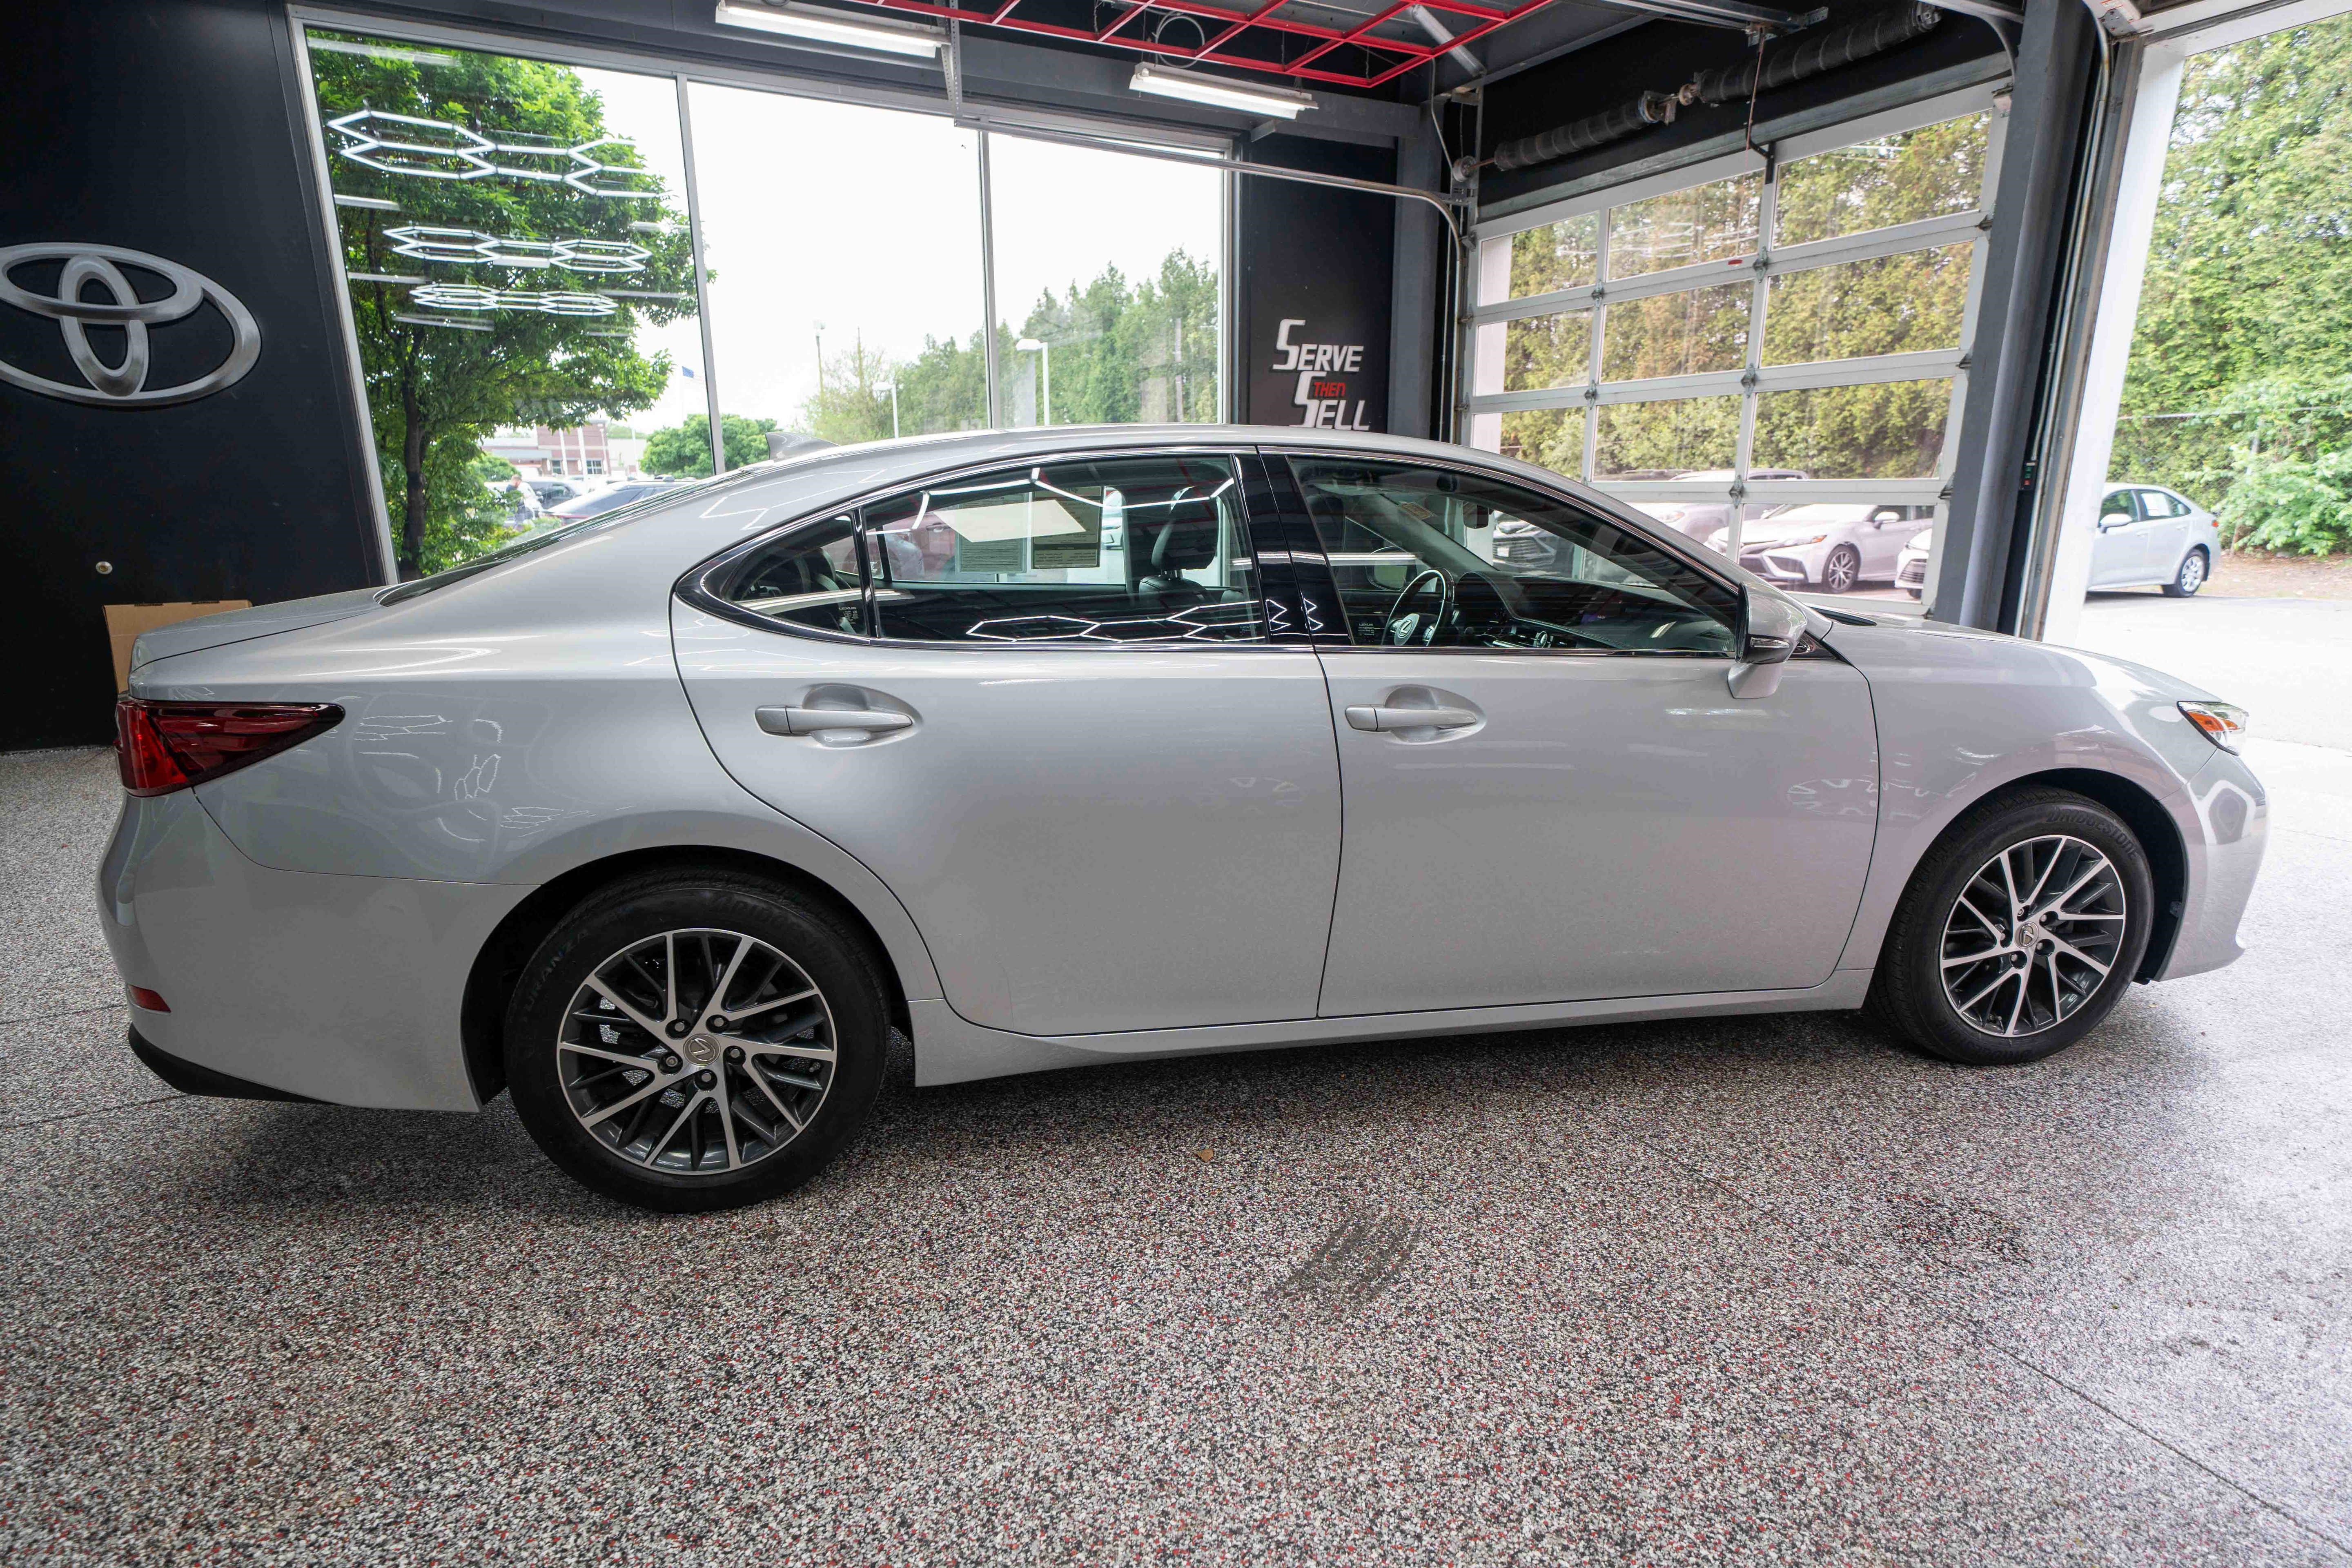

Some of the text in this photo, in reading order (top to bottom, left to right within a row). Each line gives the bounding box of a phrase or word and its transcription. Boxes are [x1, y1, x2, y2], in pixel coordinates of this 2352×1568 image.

[1272, 319, 1364, 372] SERVE
[1289, 371, 1370, 431] SELL
[1313, 382, 1345, 397] THEN
